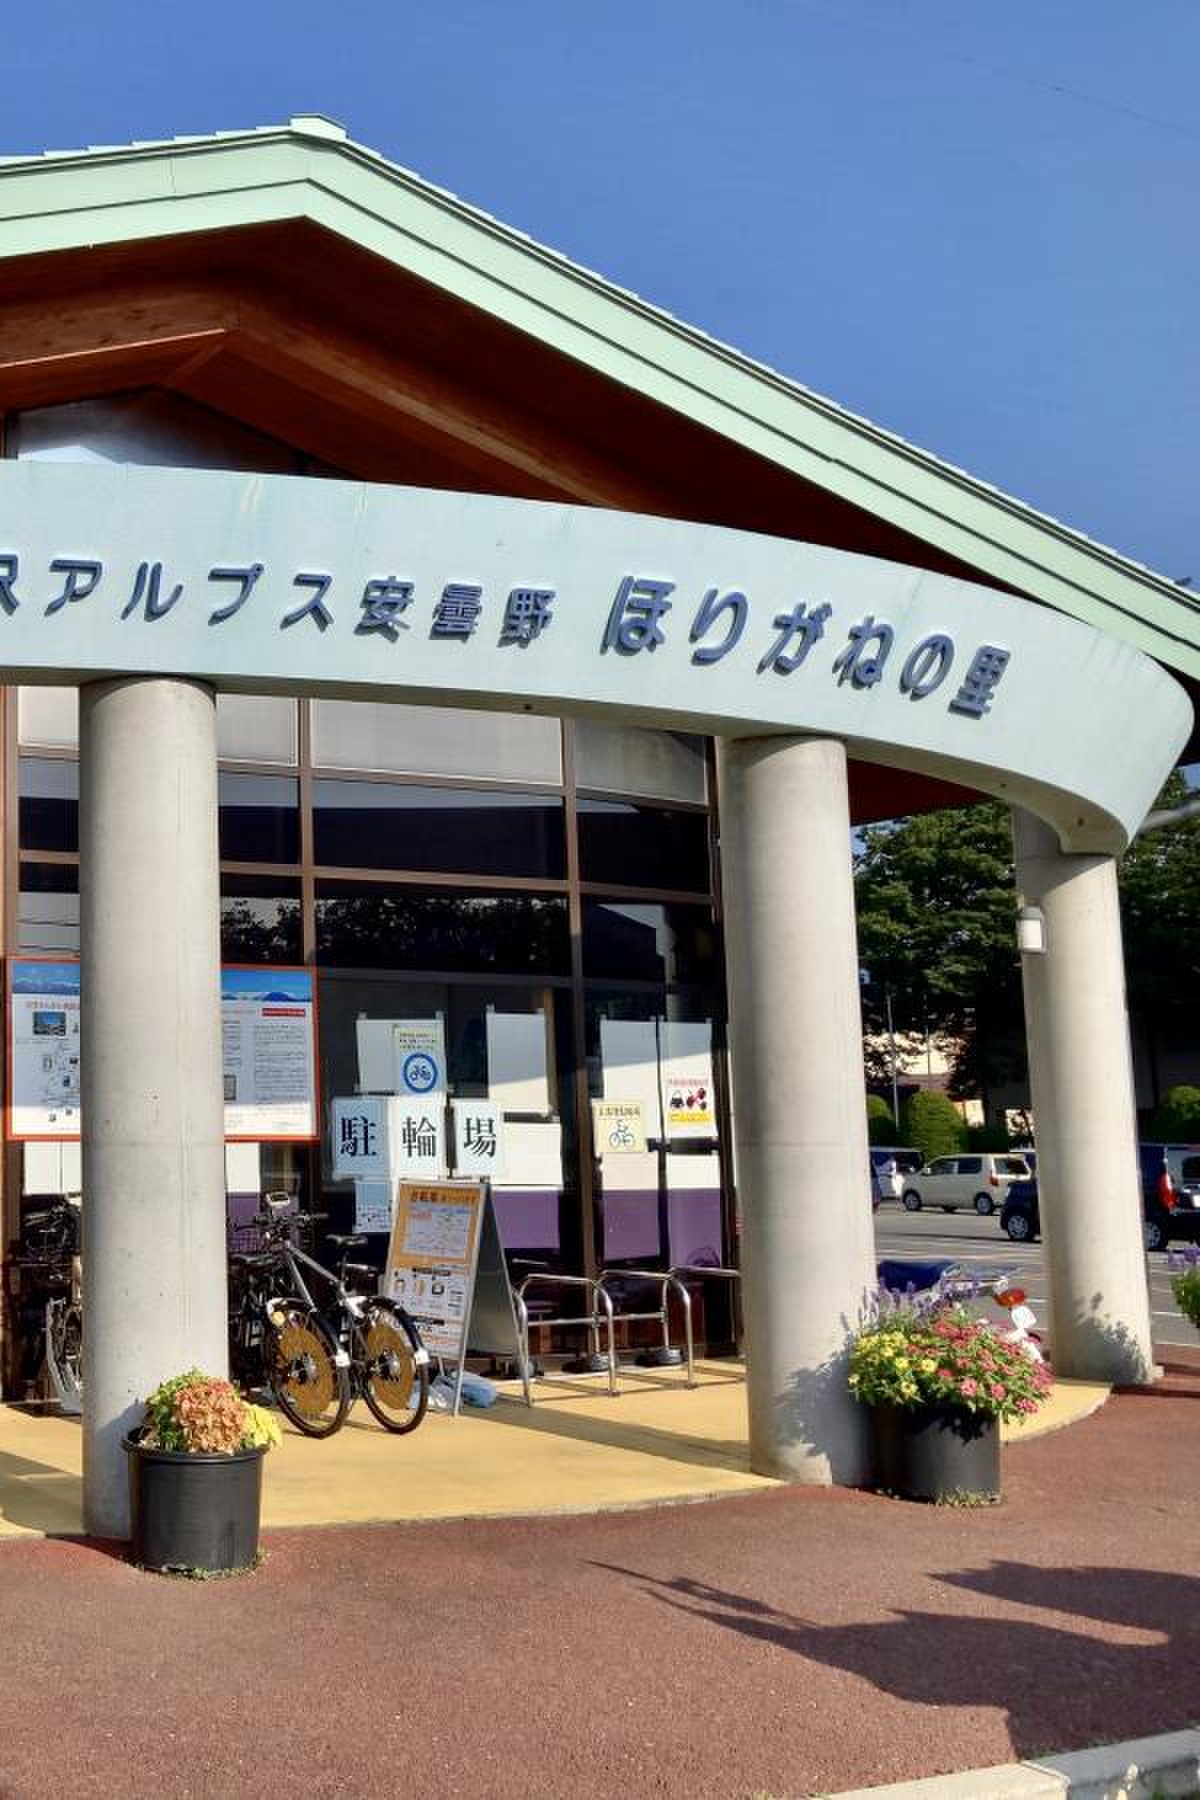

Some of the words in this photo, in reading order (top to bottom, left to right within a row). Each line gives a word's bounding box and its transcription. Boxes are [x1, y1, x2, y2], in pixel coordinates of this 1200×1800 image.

[601, 576, 1009, 718] ほりがねの里
[340, 1116, 497, 1158] 駐輪場
